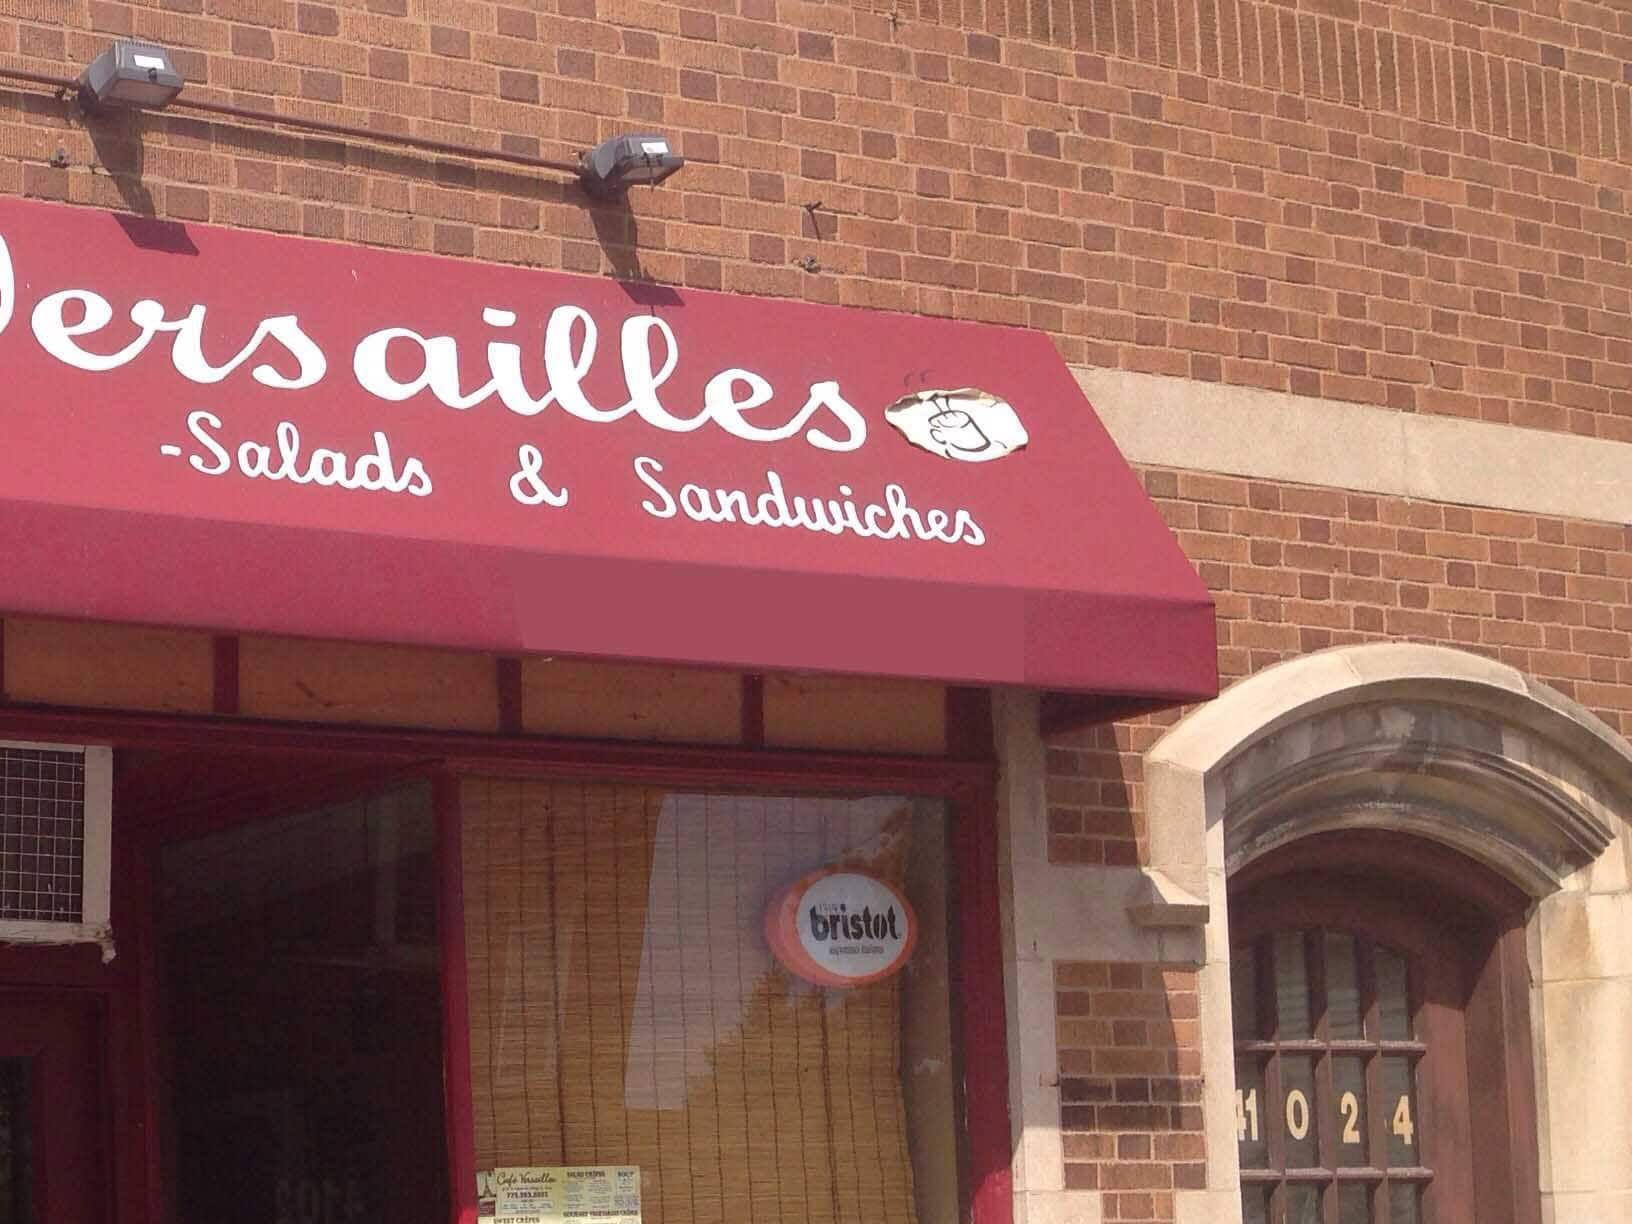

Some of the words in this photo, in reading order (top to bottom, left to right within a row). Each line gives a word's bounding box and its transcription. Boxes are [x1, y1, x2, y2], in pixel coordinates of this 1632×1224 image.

[509, 443, 569, 507] &
[633, 456, 986, 546] Sandwiches
[809, 903, 900, 942] bristot
